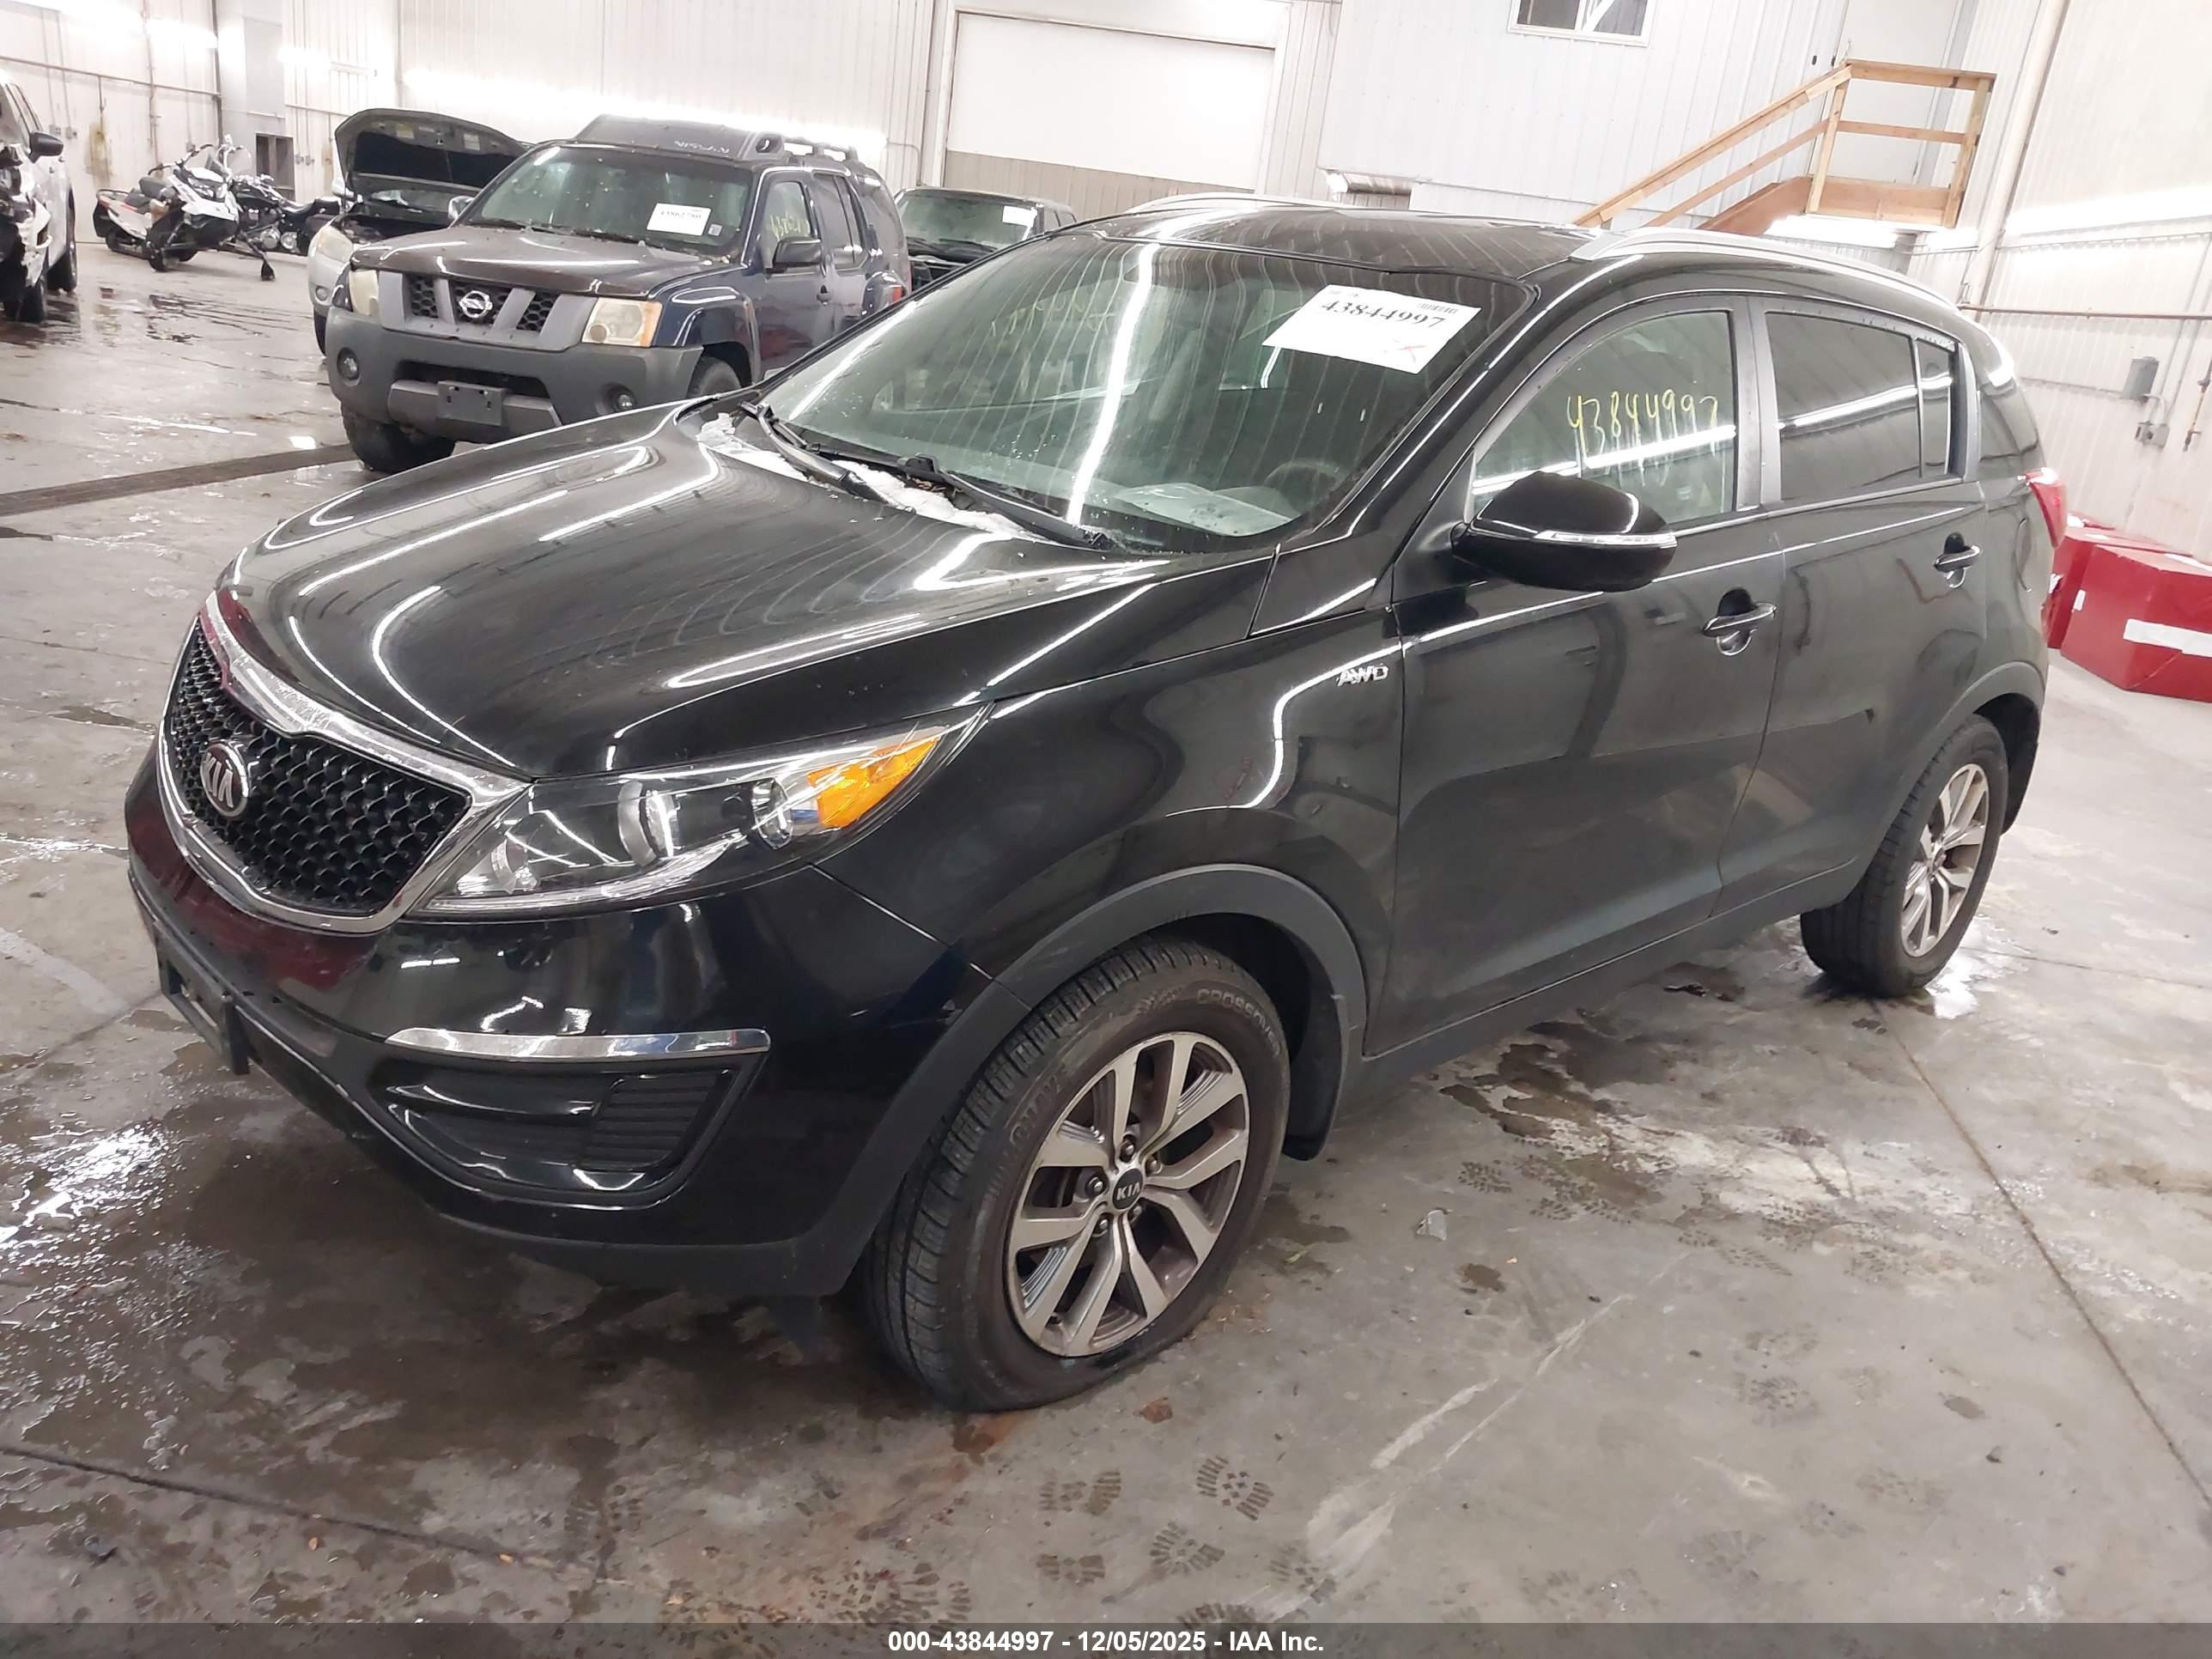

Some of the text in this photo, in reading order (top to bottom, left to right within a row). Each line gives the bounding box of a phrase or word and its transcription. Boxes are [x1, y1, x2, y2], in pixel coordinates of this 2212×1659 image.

[1321, 300, 1446, 329] 43844997
[1336, 665, 1389, 687] AWD
[202, 752, 234, 808] KIA
[1116, 1182, 1140, 1200] KIA
